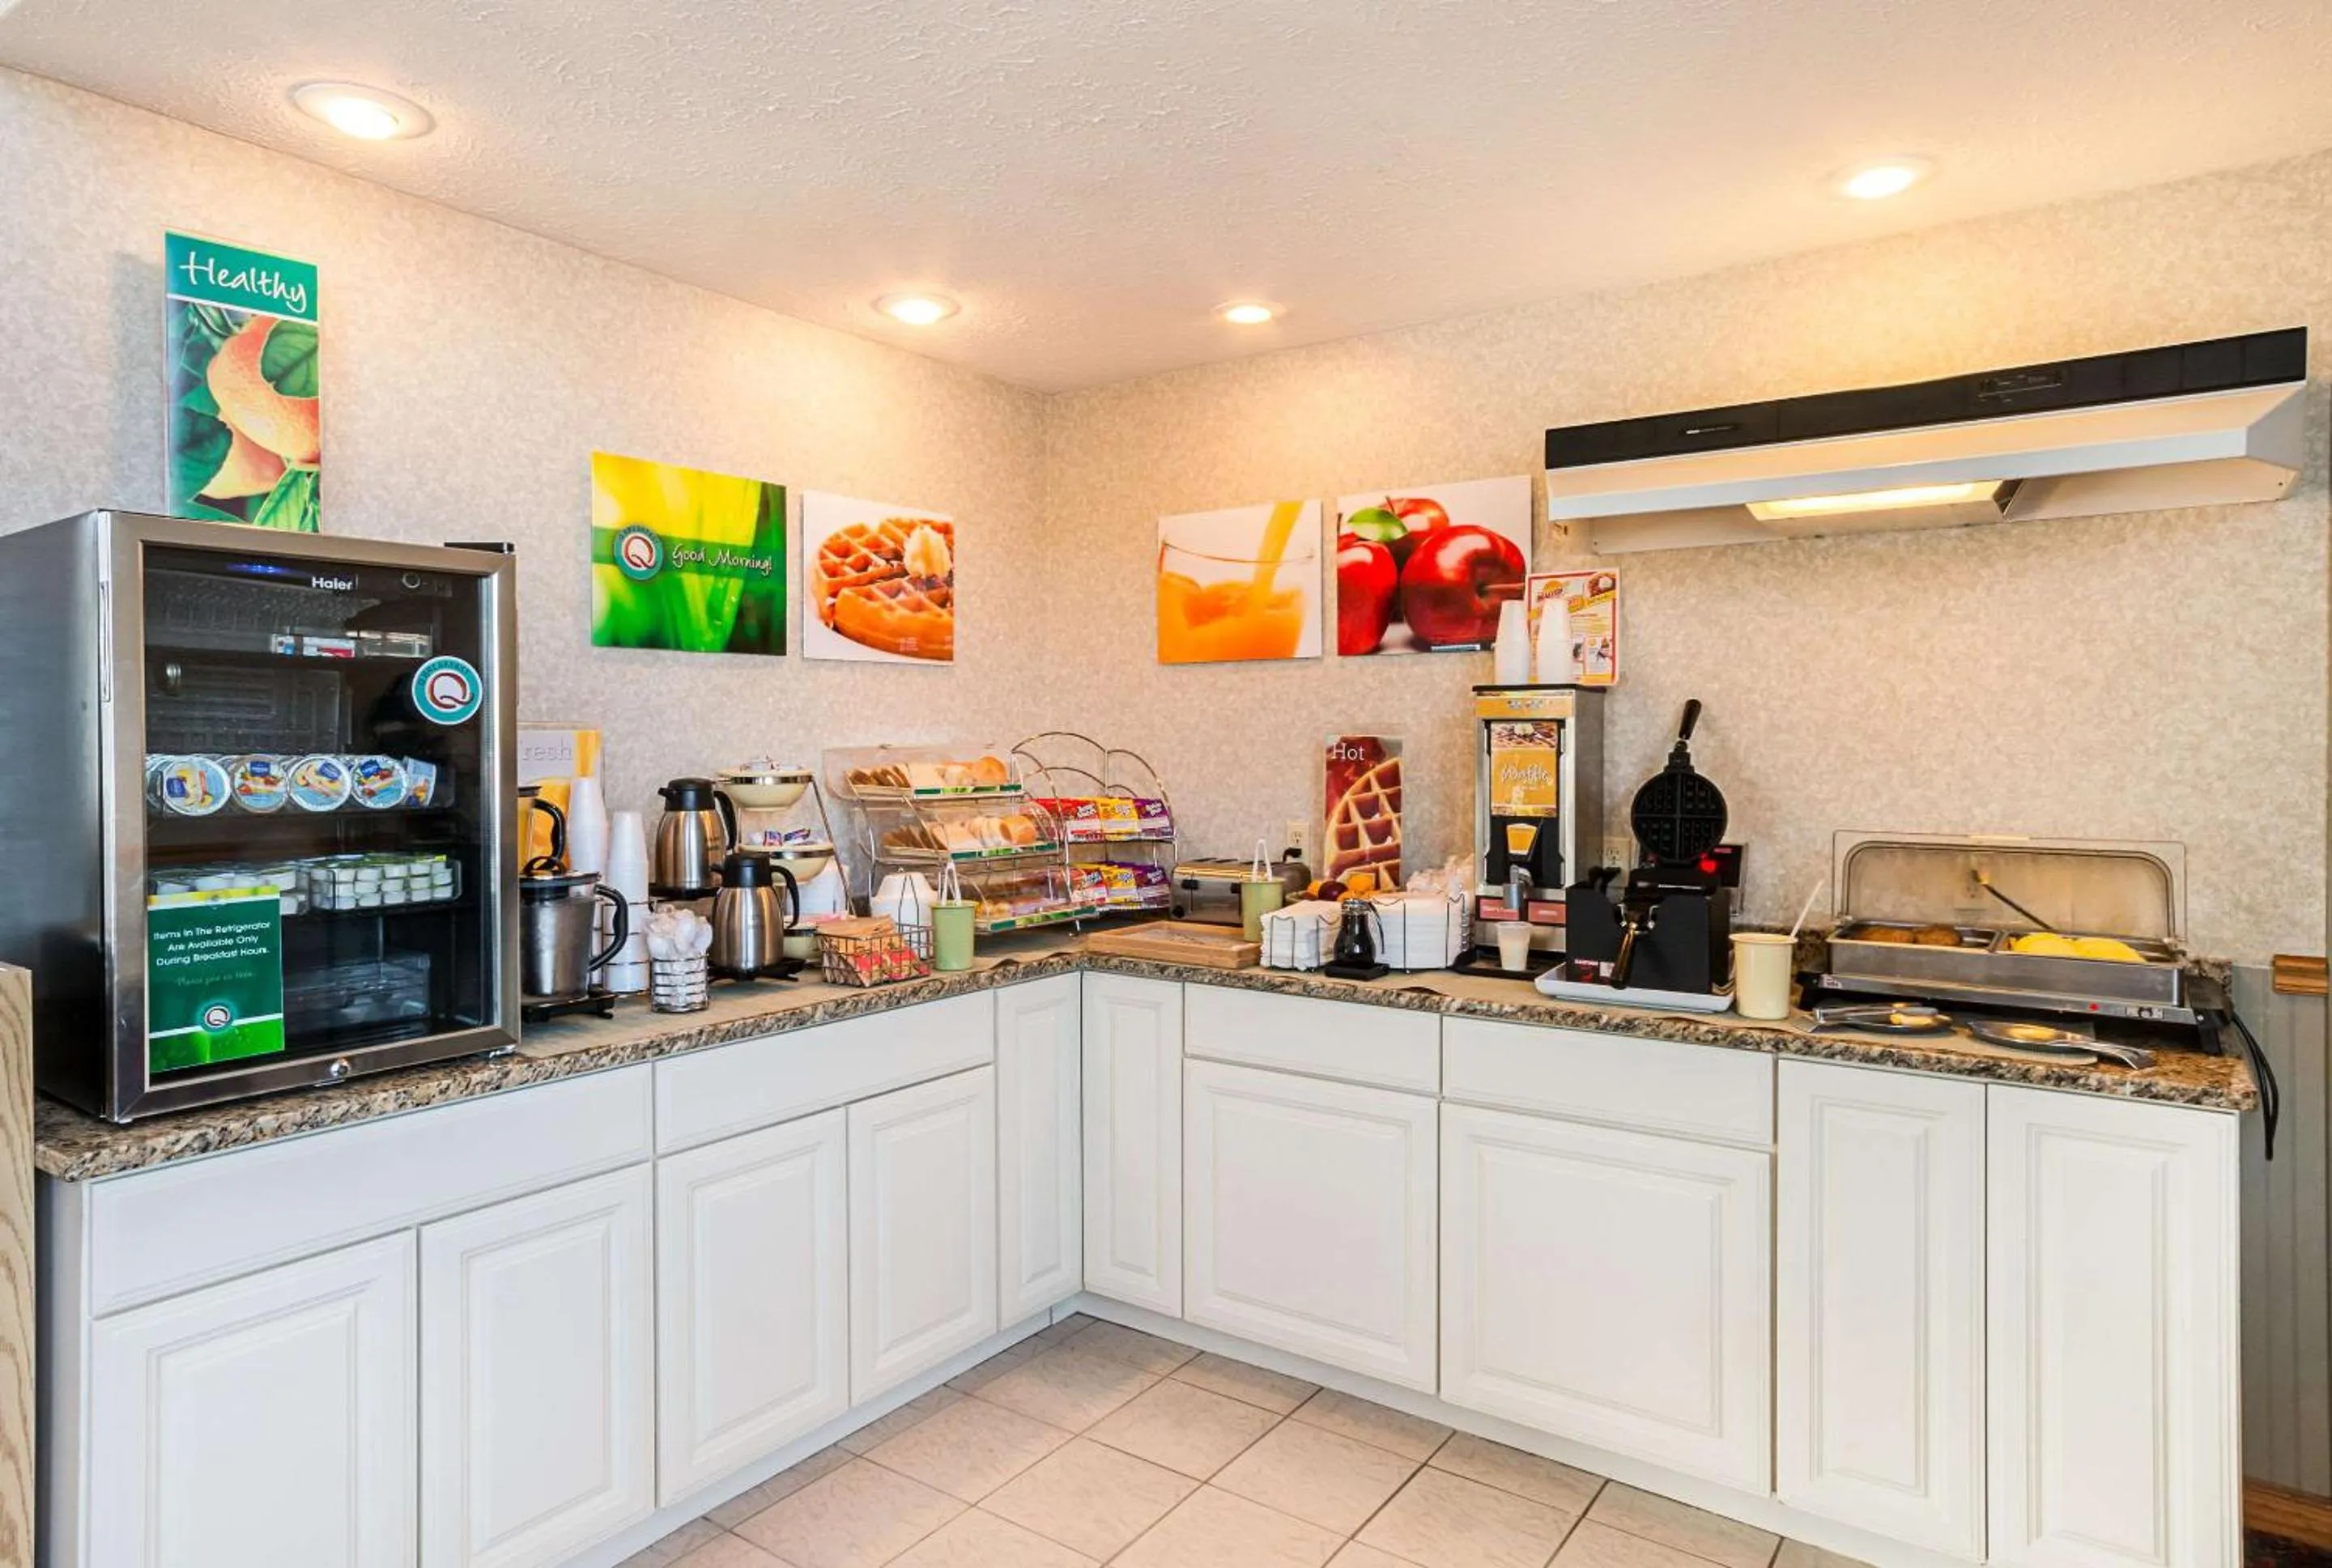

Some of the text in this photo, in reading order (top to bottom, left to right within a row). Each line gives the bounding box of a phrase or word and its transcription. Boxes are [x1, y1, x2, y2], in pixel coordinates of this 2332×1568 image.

[179, 250, 308, 313] Healthy
[671, 543, 772, 576] Good Morning!
[311, 576, 353, 590] Haier
[427, 672, 475, 709] Q
[519, 736, 573, 761] resh
[1331, 742, 1365, 761] Hot
[153, 921, 270, 940] Items In The Refrigerator
[167, 935, 259, 952] Are Available Only
[156, 956, 191, 966] During
[193, 949, 238, 963] Breakfast
